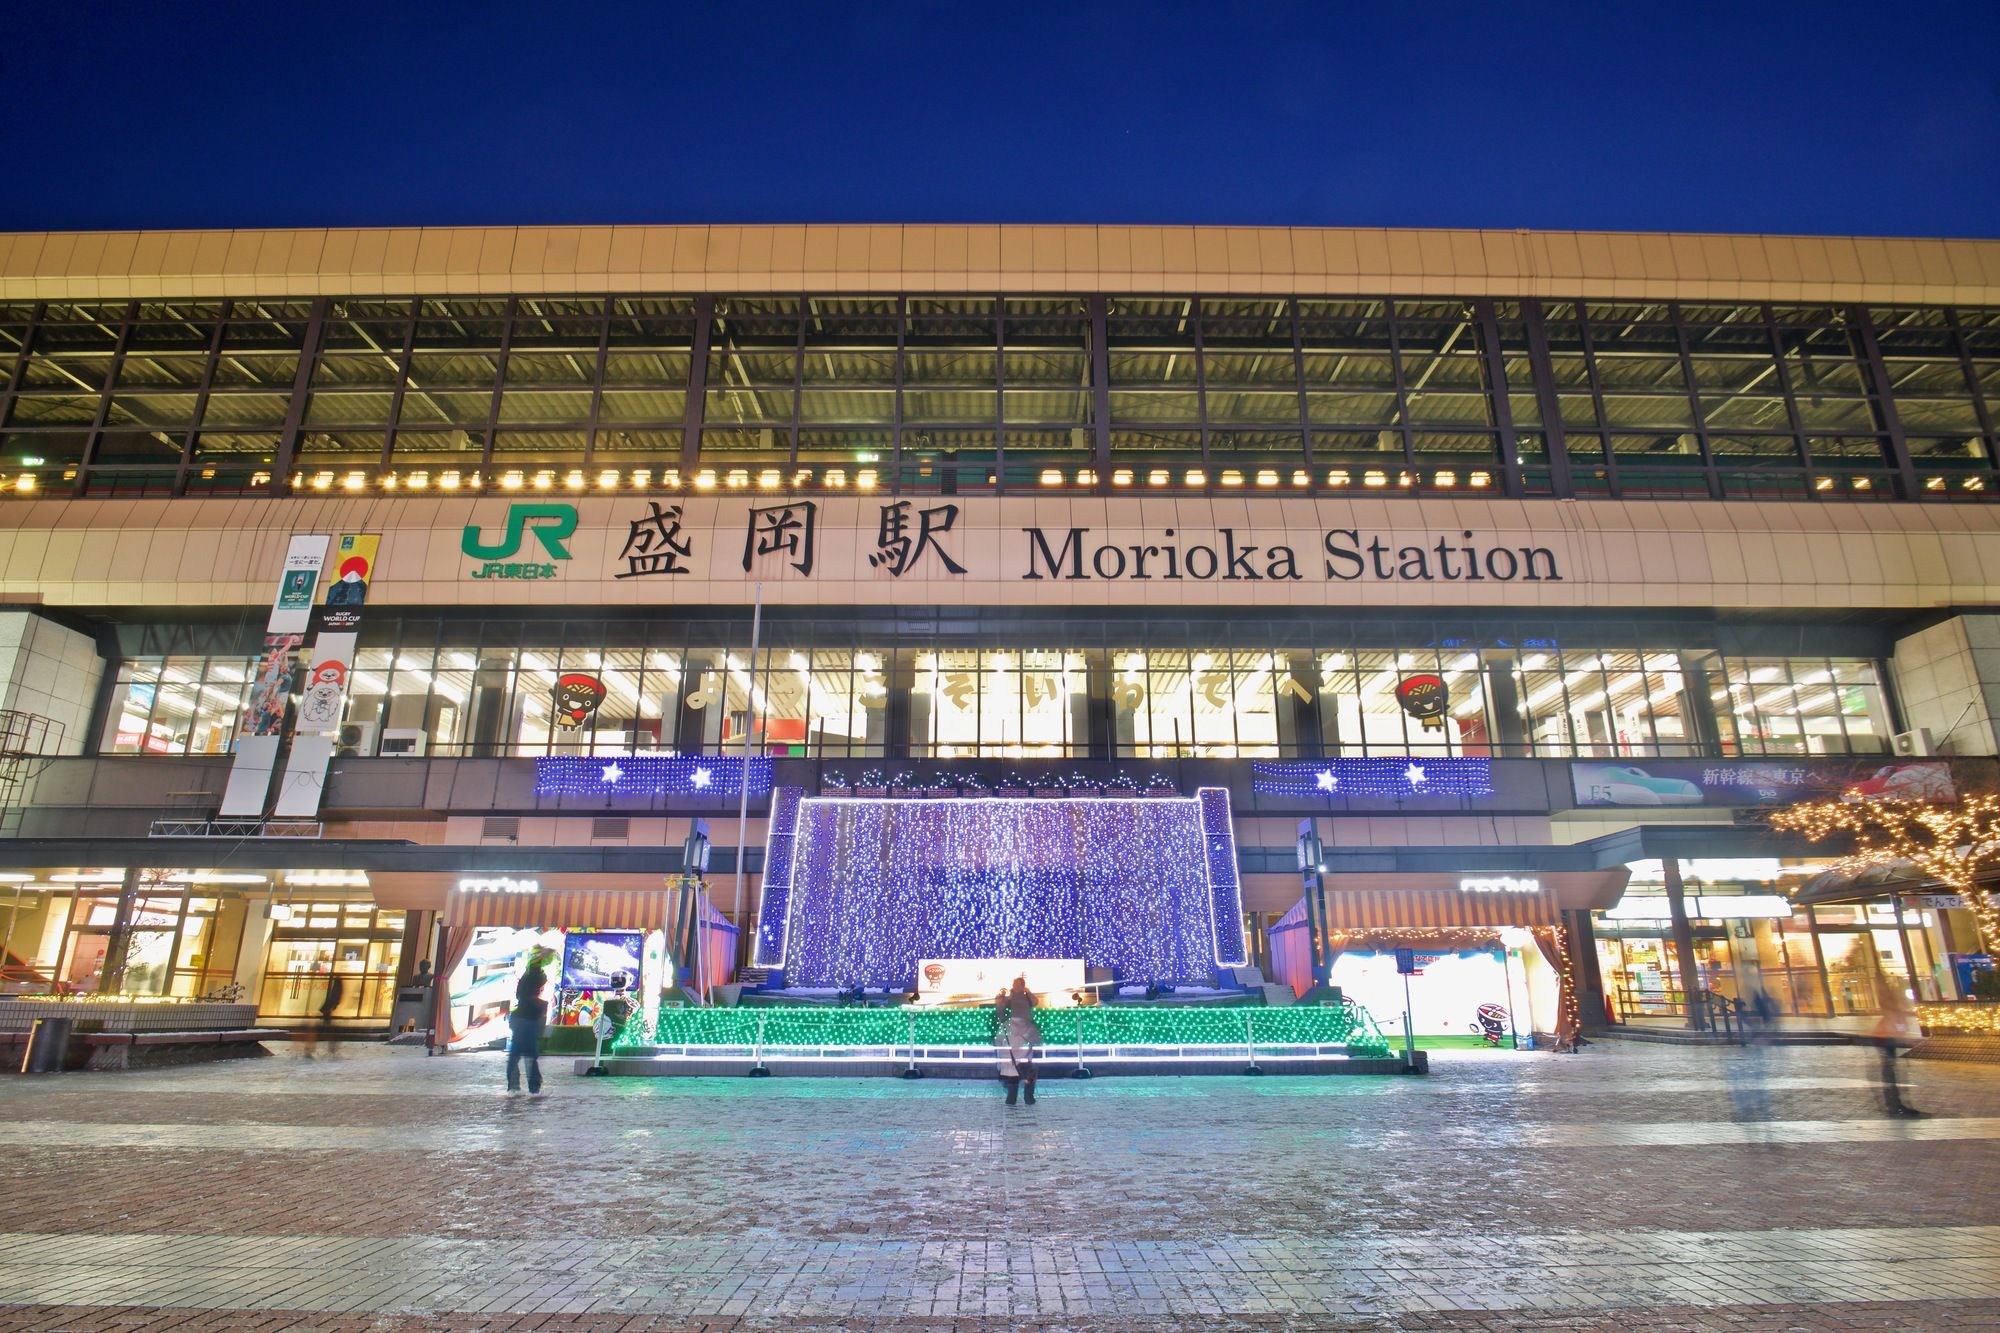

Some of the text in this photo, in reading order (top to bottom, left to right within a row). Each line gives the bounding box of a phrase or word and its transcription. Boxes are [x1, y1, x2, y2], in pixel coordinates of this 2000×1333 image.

[462, 503, 578, 560] JR
[614, 500, 1563, 581] 盛岡駅 Morioka Station
[471, 562, 558, 579] JR東日本
[1588, 785, 1613, 801] E5
